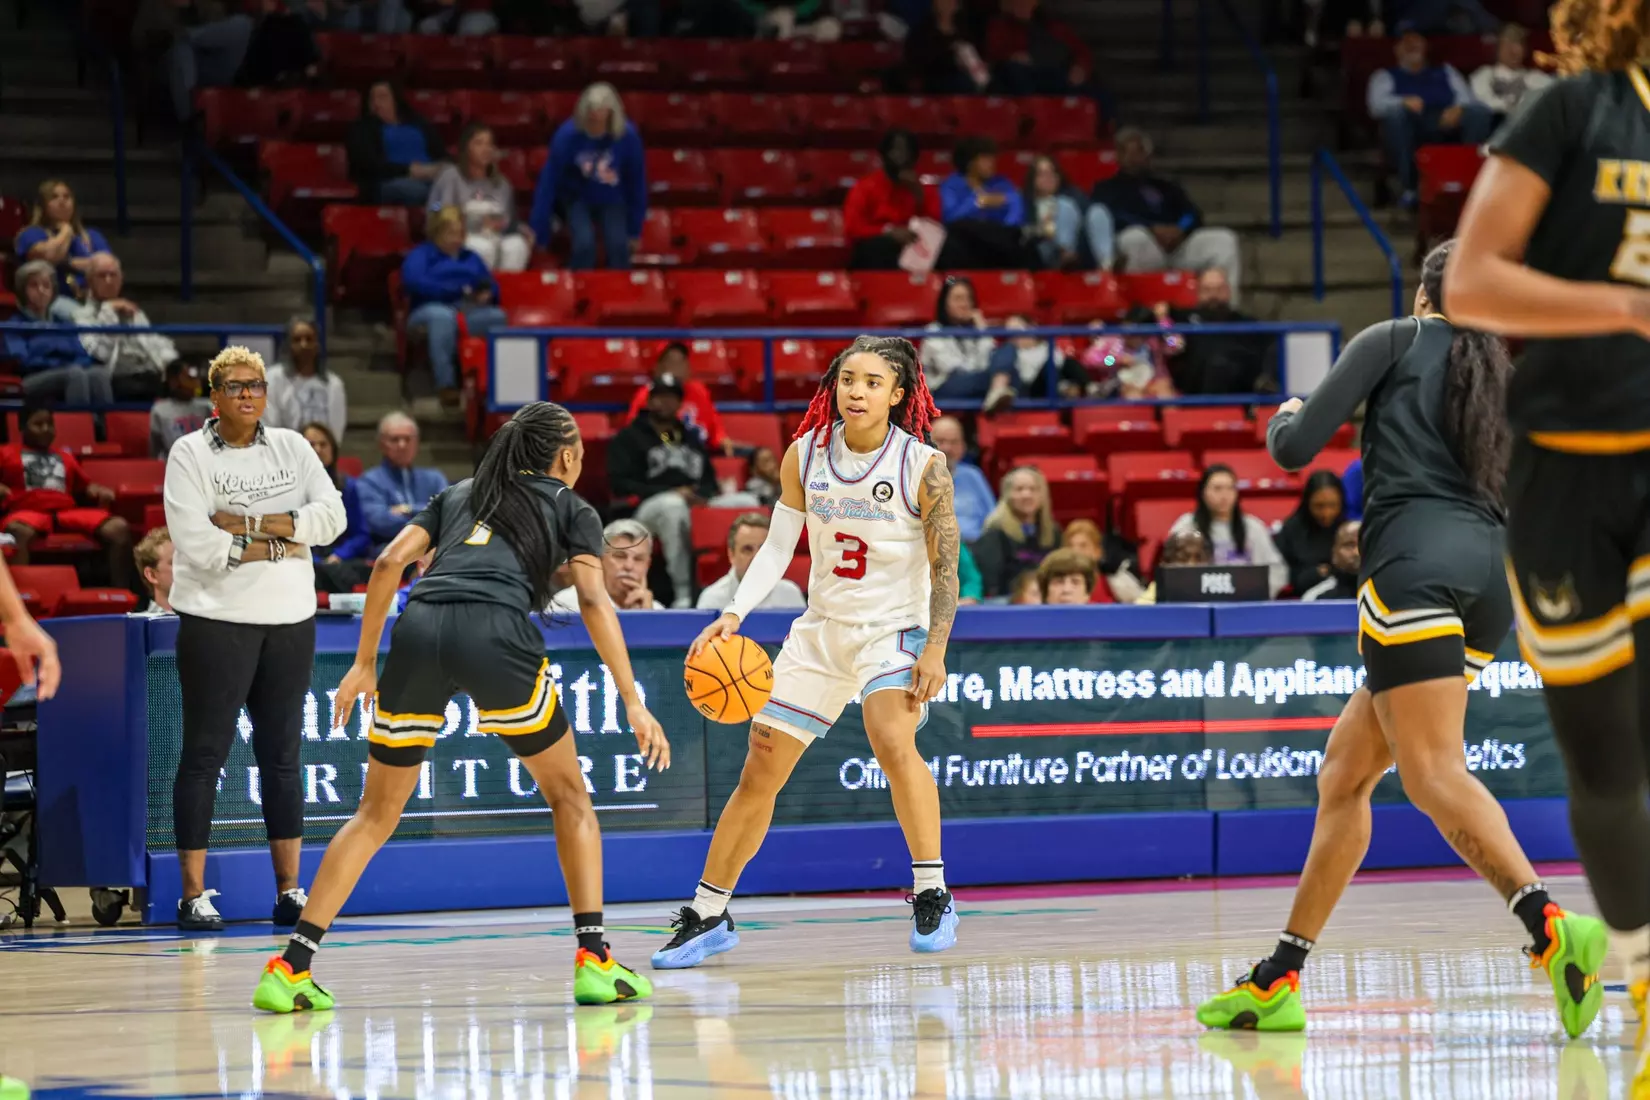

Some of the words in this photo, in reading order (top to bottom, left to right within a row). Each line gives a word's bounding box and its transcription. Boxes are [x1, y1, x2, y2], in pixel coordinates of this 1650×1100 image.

[832, 531, 868, 580] 3
[1000, 665, 1156, 700] Mattress
[1161, 660, 1226, 698] and
[1230, 658, 1368, 704] Applian
[945, 753, 1070, 786] Furniture
[1075, 750, 1178, 783] Partner
[1181, 747, 1213, 780] of
[1216, 745, 1326, 780] Louisian
